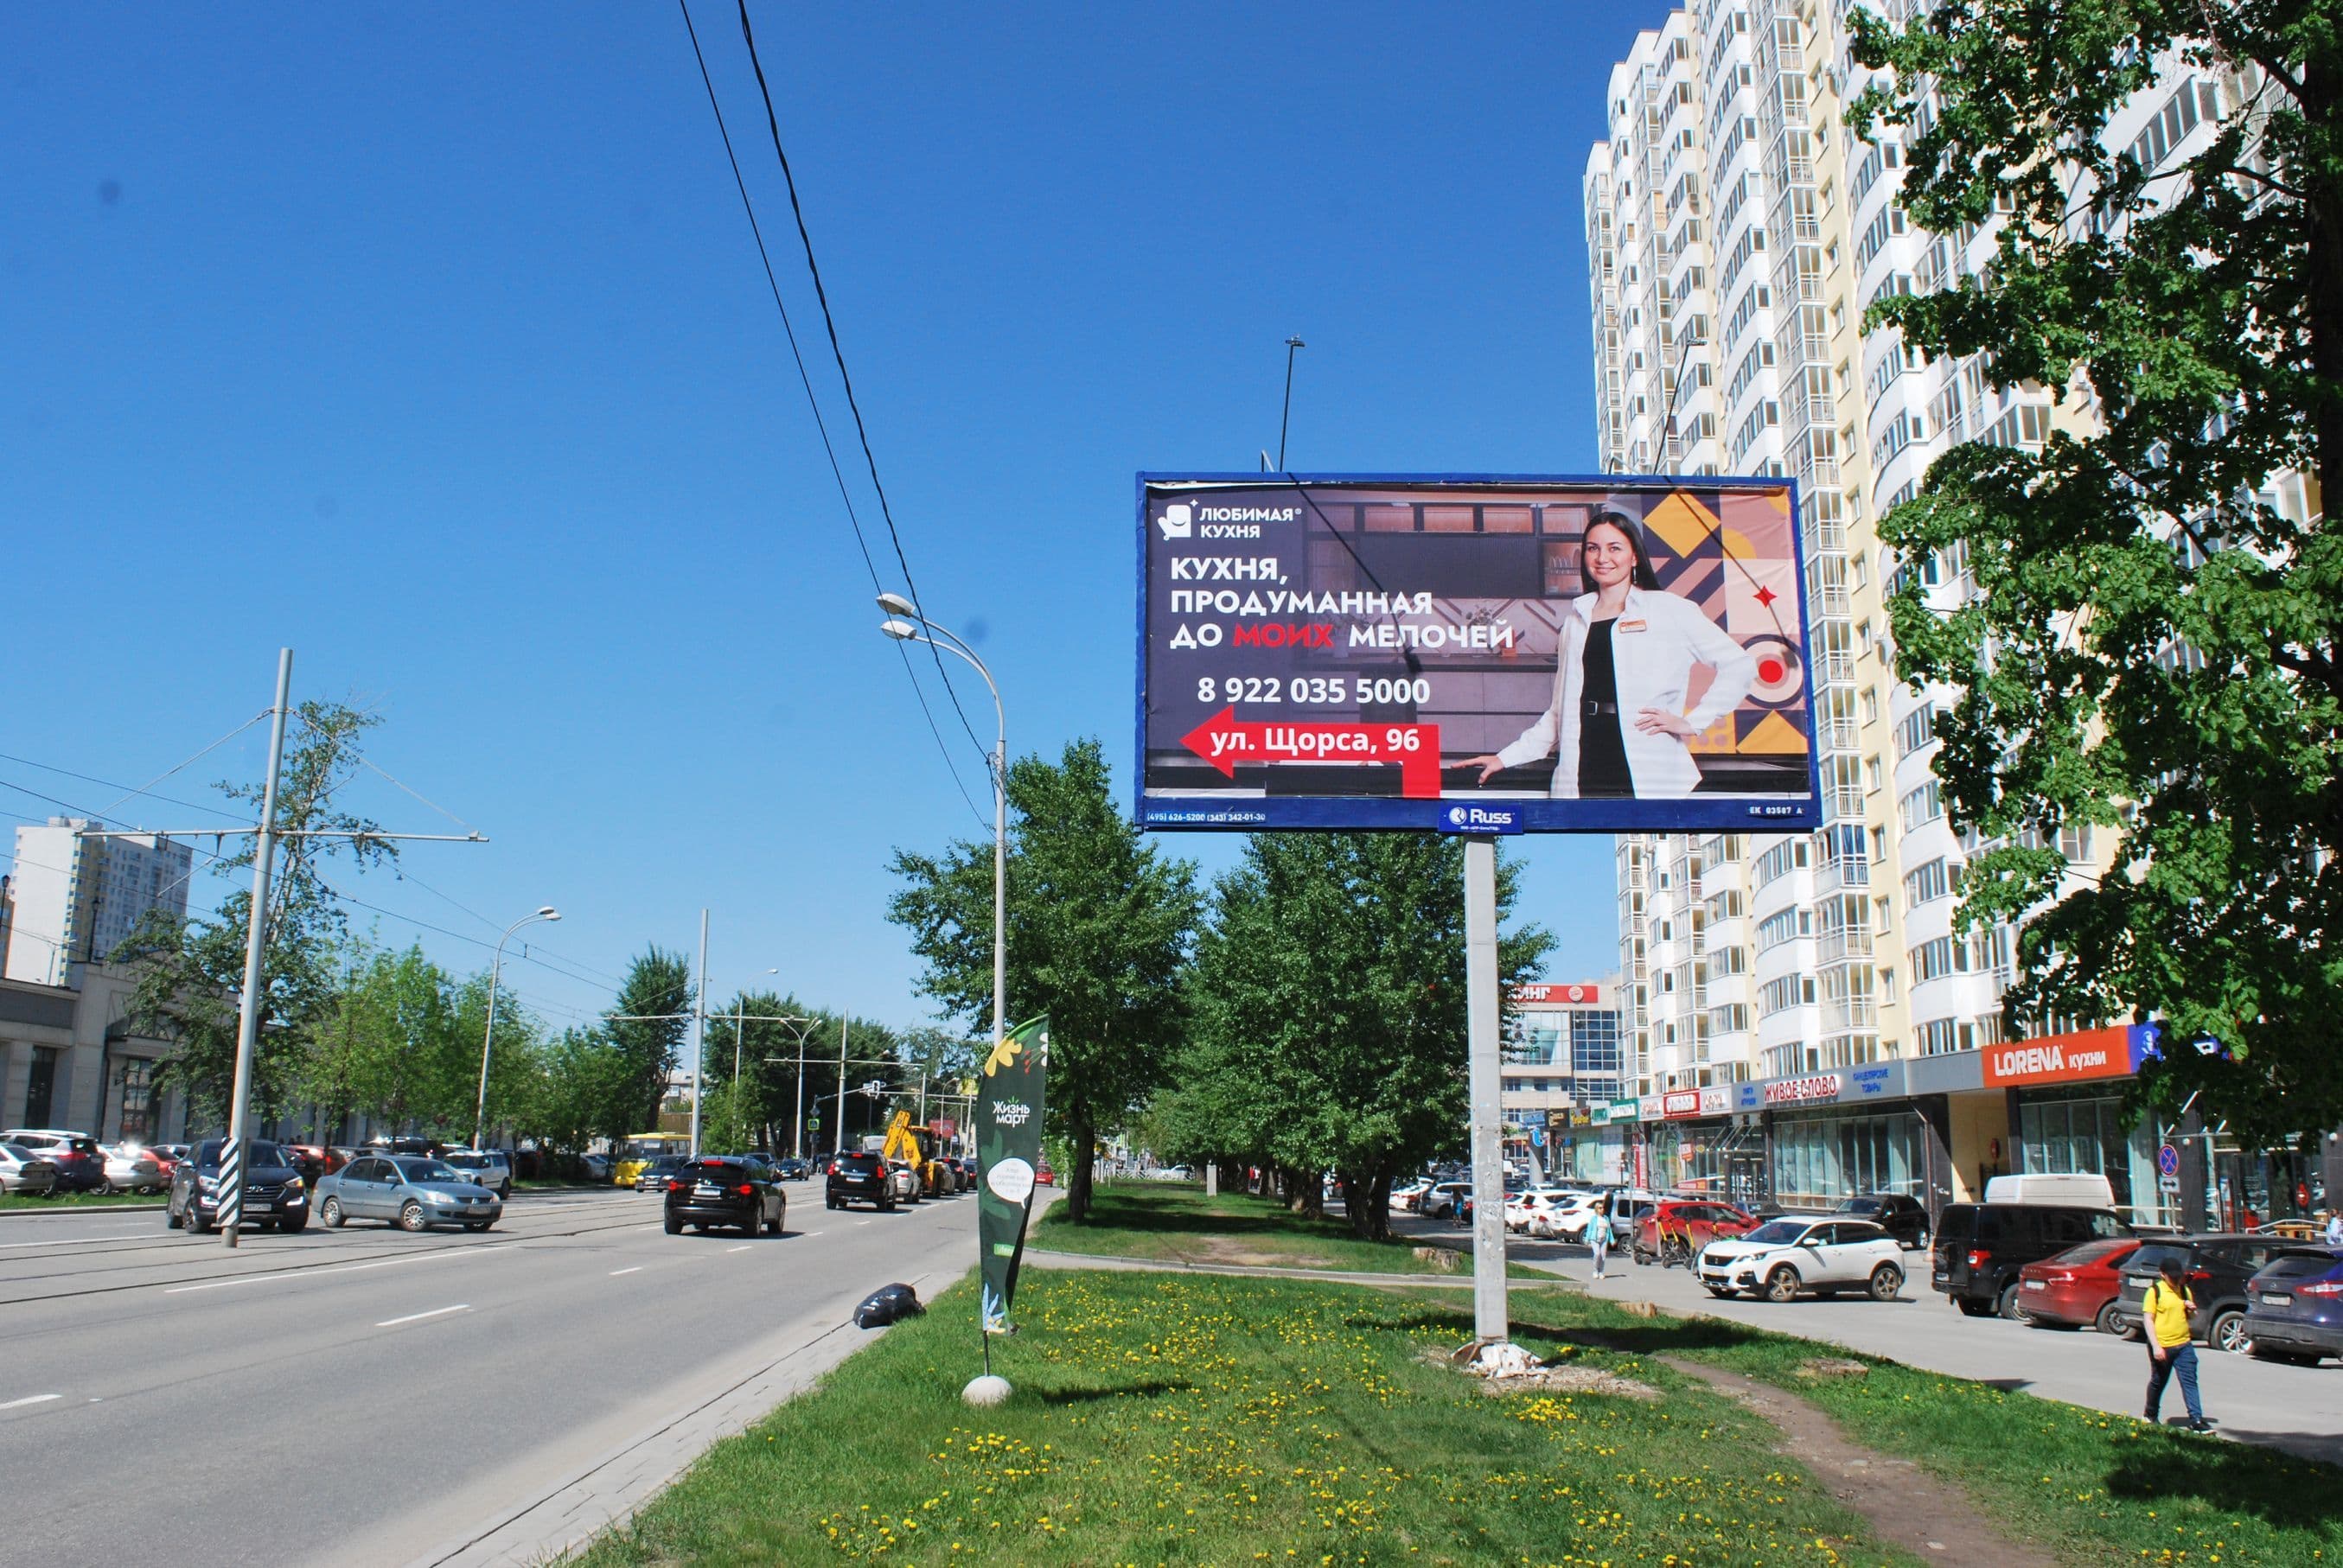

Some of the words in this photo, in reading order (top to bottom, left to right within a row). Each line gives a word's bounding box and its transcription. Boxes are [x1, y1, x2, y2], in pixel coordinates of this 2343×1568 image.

[1200, 525, 1261, 539] КУХНЯ
[1171, 558, 1288, 585] КУХНЯ,
[1171, 590, 1433, 616] ПРОДУМАННАЯ
[1169, 623, 1223, 649] ДО
[1233, 623, 1334, 648] МОИХ
[1349, 619, 1513, 649] МЕЛОЧЕЙ
[1197, 677, 1216, 703] 8
[1224, 677, 1281, 704] 922
[1290, 678, 1346, 704] 035
[1356, 679, 1431, 704] 5000
[1210, 731, 1255, 756] ул.
[1265, 728, 1377, 757] Щорса,
[1386, 728, 1420, 752] 96
[1168, 813, 1205, 821] 626-5200
[1207, 813, 1227, 822] (343)
[1228, 813, 1266, 821] 342-01-30
[1994, 1045, 2065, 1077] LORENA
[2069, 1050, 2107, 1071] кухни
[1764, 1080, 1798, 1102] ЖИВОЕ
[1800, 1075, 1837, 1097] СЛОВО
[993, 1100, 1031, 1114] Жизнь
